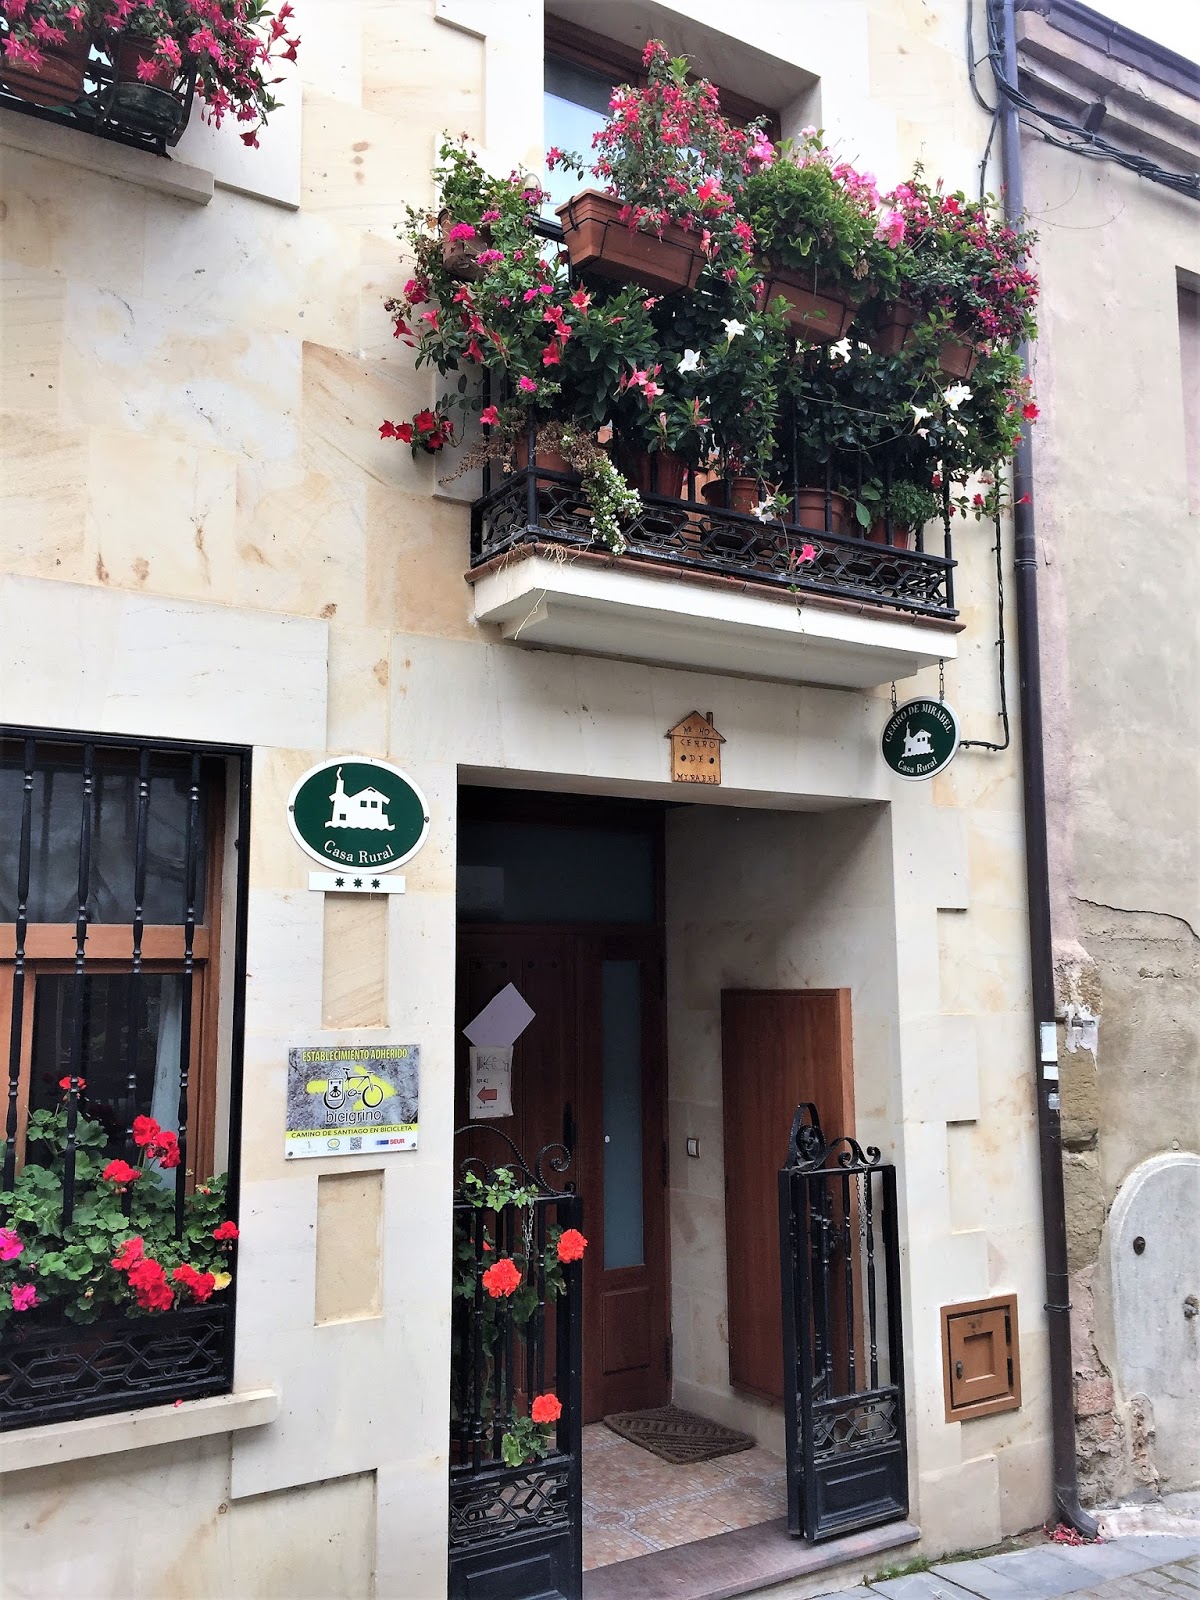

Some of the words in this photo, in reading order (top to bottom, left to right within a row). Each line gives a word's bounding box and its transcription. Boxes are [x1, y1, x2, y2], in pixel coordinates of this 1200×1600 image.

[885, 710, 907, 742] CERRO
[908, 703, 920, 715] DE
[921, 703, 953, 734] MIRABEL
[680, 739, 716, 748] CERRO
[689, 755, 703, 763] DE
[898, 760, 914, 773] Casa
[916, 756, 938, 773] Rural
[676, 772, 718, 783] MIRABEL
[324, 840, 354, 862] Casa
[359, 844, 394, 863] Rural
[302, 1049, 370, 1062] ESTABLECIMIENTO
[370, 1048, 408, 1060] ADHERIDO
[325, 1110, 382, 1125] bicigrino
[291, 1131, 321, 1139] CAMINO
[333, 1127, 369, 1136] SANTIAGO
[380, 1125, 413, 1133] BICICLETA
